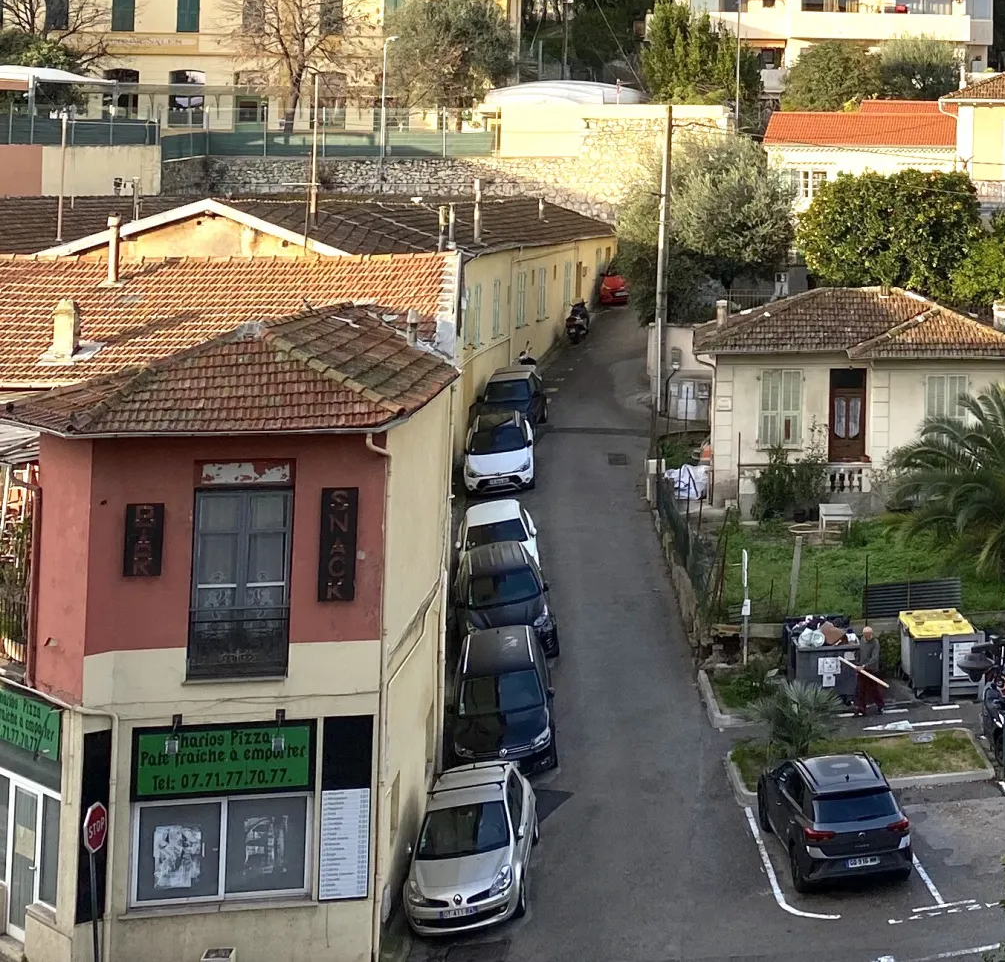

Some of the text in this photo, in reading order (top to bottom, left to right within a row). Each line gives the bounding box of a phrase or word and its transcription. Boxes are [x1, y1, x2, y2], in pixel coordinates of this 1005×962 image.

[326, 490, 350, 599] SNACK
[230, 729, 271, 746] Pizza
[229, 746, 239, 761] à
[152, 775, 175, 791] Tel:
[89, 816, 105, 839] STOP
